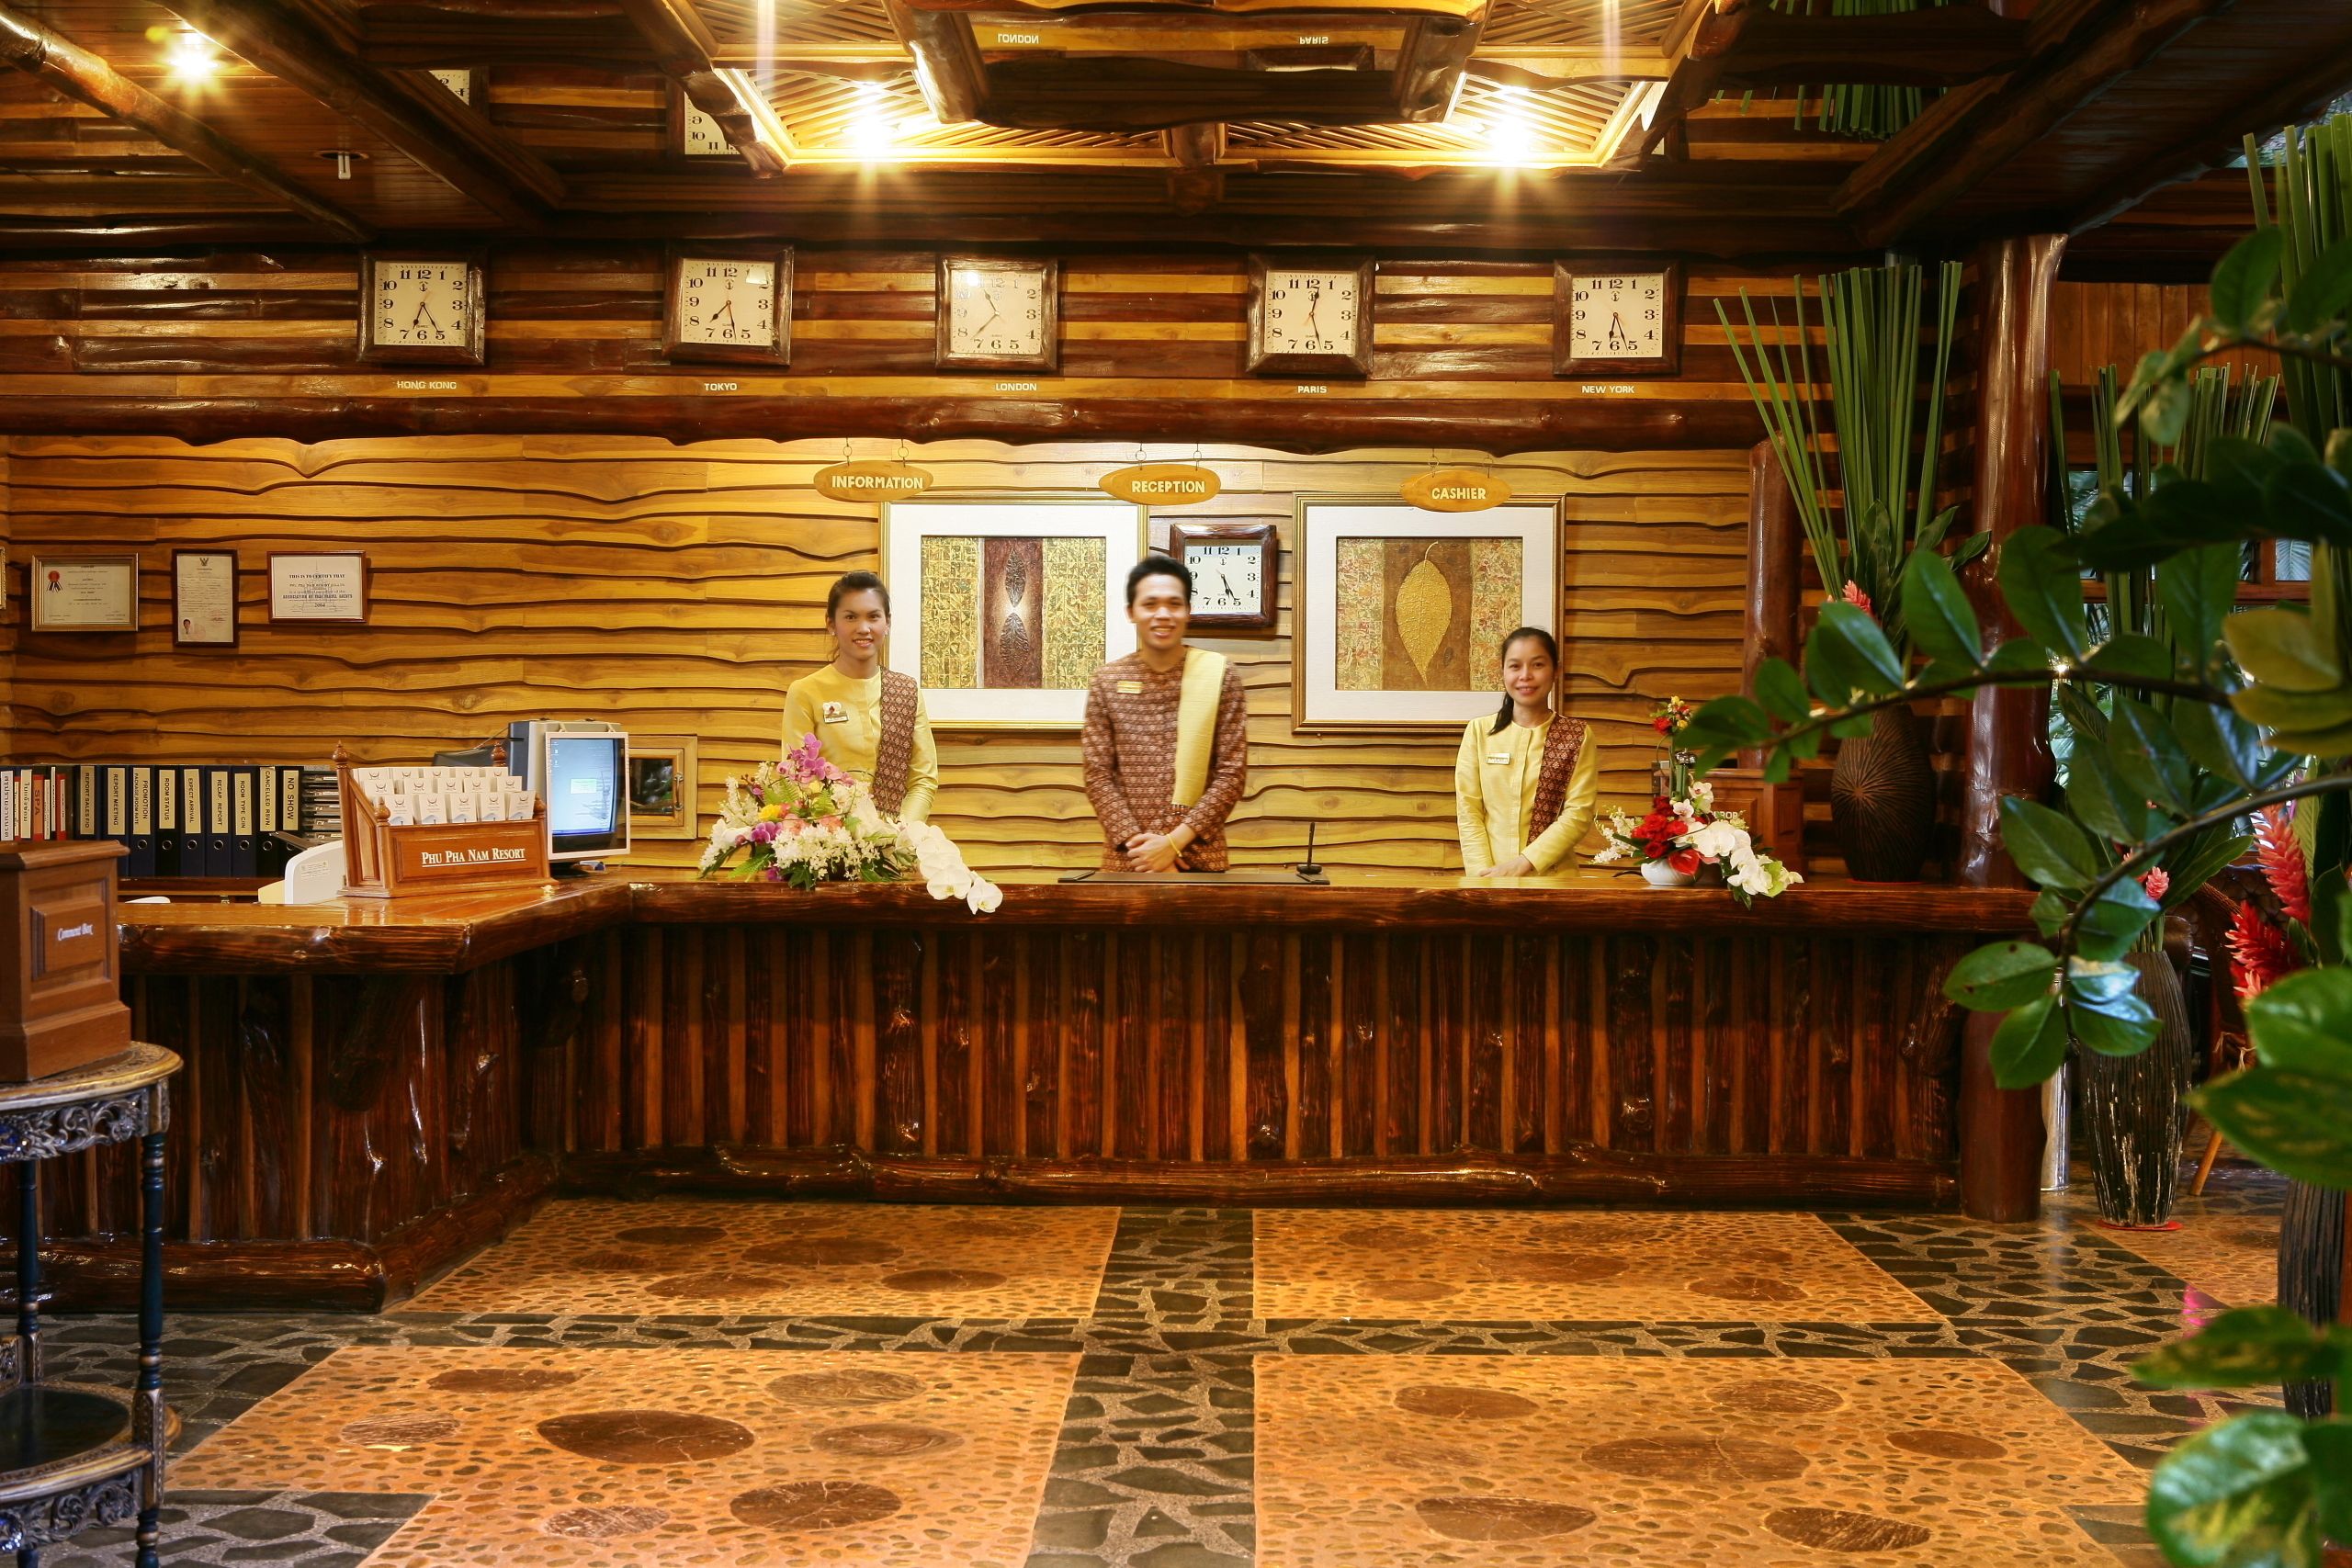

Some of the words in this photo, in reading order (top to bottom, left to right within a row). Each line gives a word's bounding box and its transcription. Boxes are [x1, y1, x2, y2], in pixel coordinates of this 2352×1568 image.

[400, 270, 411, 279] 11
[417, 270, 431, 279] 12
[439, 270, 445, 280] 1
[707, 267, 717, 276] 11
[724, 267, 737, 276] 12
[383, 281, 397, 290] 10
[453, 281, 463, 290] 2
[690, 278, 703, 288] 10
[1289, 279, 1299, 288] 11
[1306, 279, 1320, 288] 12
[1329, 280, 1333, 289] 1
[1592, 279, 1602, 289] 11
[1610, 279, 1623, 288] 12
[1632, 279, 1636, 289] 1
[1027, 289, 1036, 299] 2
[1272, 290, 1285, 299] 10
[1341, 290, 1351, 300] 2
[1575, 291, 1589, 301] 10
[1645, 289, 1655, 299] 2
[383, 299, 393, 309] 9
[452, 300, 462, 310] 3
[690, 297, 699, 307] 9
[758, 299, 768, 310] 3
[1027, 310, 1036, 320] 3
[1272, 309, 1282, 318] 9
[1341, 310, 1351, 320] 3
[1576, 310, 1585, 320] 9
[1645, 310, 1655, 320] 3
[384, 318, 393, 328] 8
[451, 321, 461, 330] 4
[690, 316, 699, 326] 8
[757, 320, 767, 329] 4
[400, 330, 410, 339] 7
[417, 330, 427, 340] 6
[435, 331, 445, 340] 5
[706, 328, 715, 337] 7
[723, 329, 732, 338] 6
[741, 329, 751, 339] 5
[958, 327, 967, 337] 8
[1025, 330, 1035, 339] 4
[1272, 328, 1282, 337] 8
[1340, 331, 1350, 340] 4
[1577, 330, 1586, 339] 8
[1645, 330, 1654, 340] 4
[974, 339, 984, 348] 7
[991, 340, 1001, 349] 6
[1010, 340, 1019, 349] 5
[1288, 340, 1298, 349] 7
[1306, 340, 1316, 350] 6
[1324, 341, 1333, 350] 5
[1592, 341, 1602, 350] 7
[1610, 341, 1620, 351] 6
[1628, 341, 1637, 350] 5
[397, 380, 426, 389] HONG
[429, 381, 457, 389] KONG
[705, 383, 737, 391] TOKYO
[832, 476, 922, 489] INFORMATION
[1132, 481, 1205, 493] RECEPTION
[1431, 487, 1487, 500] CASHIER
[1204, 547, 1212, 555] 11
[1218, 547, 1229, 555] 12
[1190, 556, 1201, 564] 10
[1190, 571, 1197, 580] 9
[1248, 573, 1256, 581] 3
[1247, 590, 1254, 598] 4
[1204, 597, 1211, 605] 7
[1218, 598, 1226, 606] 6
[1233, 598, 1241, 606] 5
[288, 777, 294, 790] NO
[421, 852, 442, 863] PHU
[445, 850, 465, 863] PHA
[468, 849, 489, 862] NAM
[492, 848, 525, 860] RESORT
